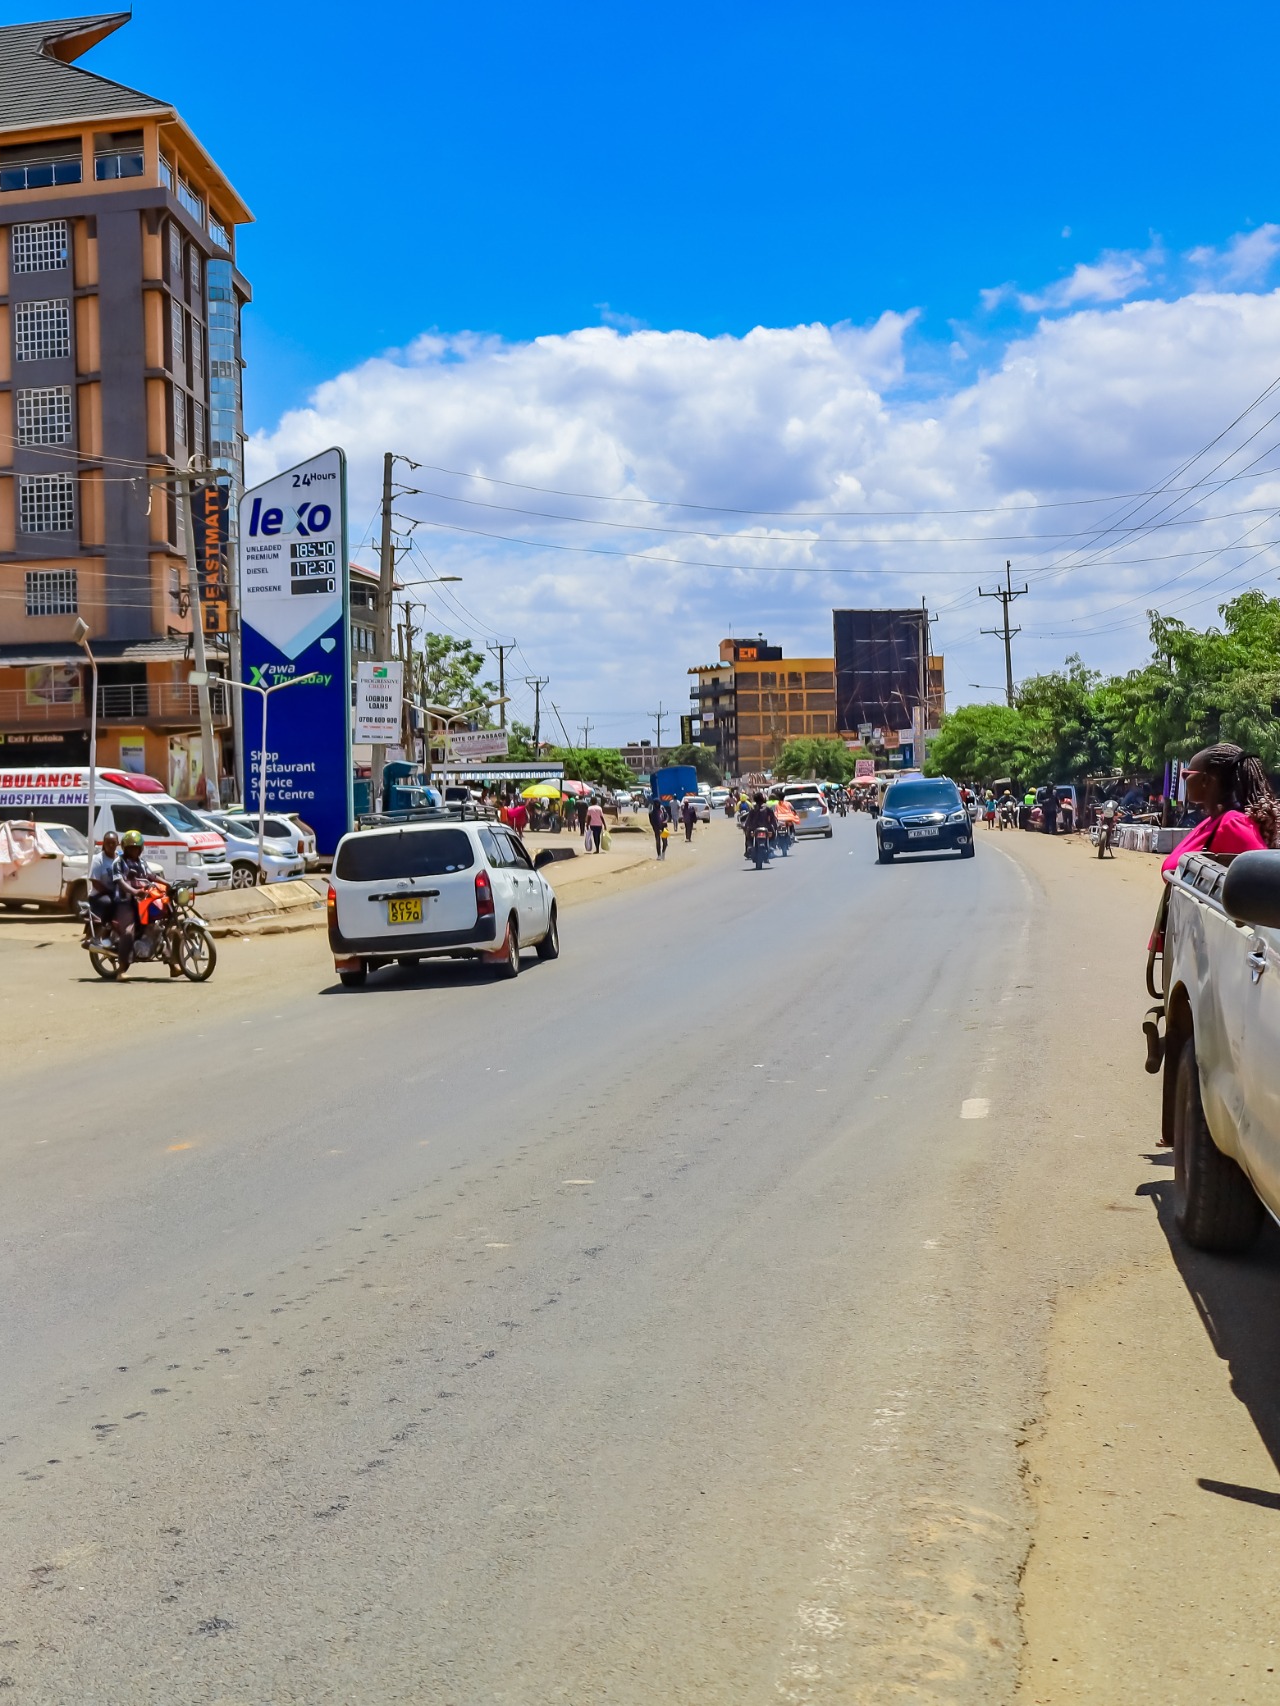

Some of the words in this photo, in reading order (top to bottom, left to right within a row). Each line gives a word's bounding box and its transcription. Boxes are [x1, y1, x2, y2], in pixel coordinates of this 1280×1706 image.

[249, 497, 331, 537] lexo
[205, 489, 220, 598] EASTMATT
[246, 544, 282, 553] UNLEADED
[246, 553, 279, 561] PREMIUM
[247, 585, 282, 593] KEROSENE
[365, 695, 392, 703] LOGBOOK
[7, 735, 25, 743] Exit
[32, 734, 64, 742] Kutoka
[0, 793, 54, 805] HOSPITAL
[57, 793, 96, 804] ANNE
[278, 789, 315, 800] Centre
[391, 901, 412, 914] KCC
